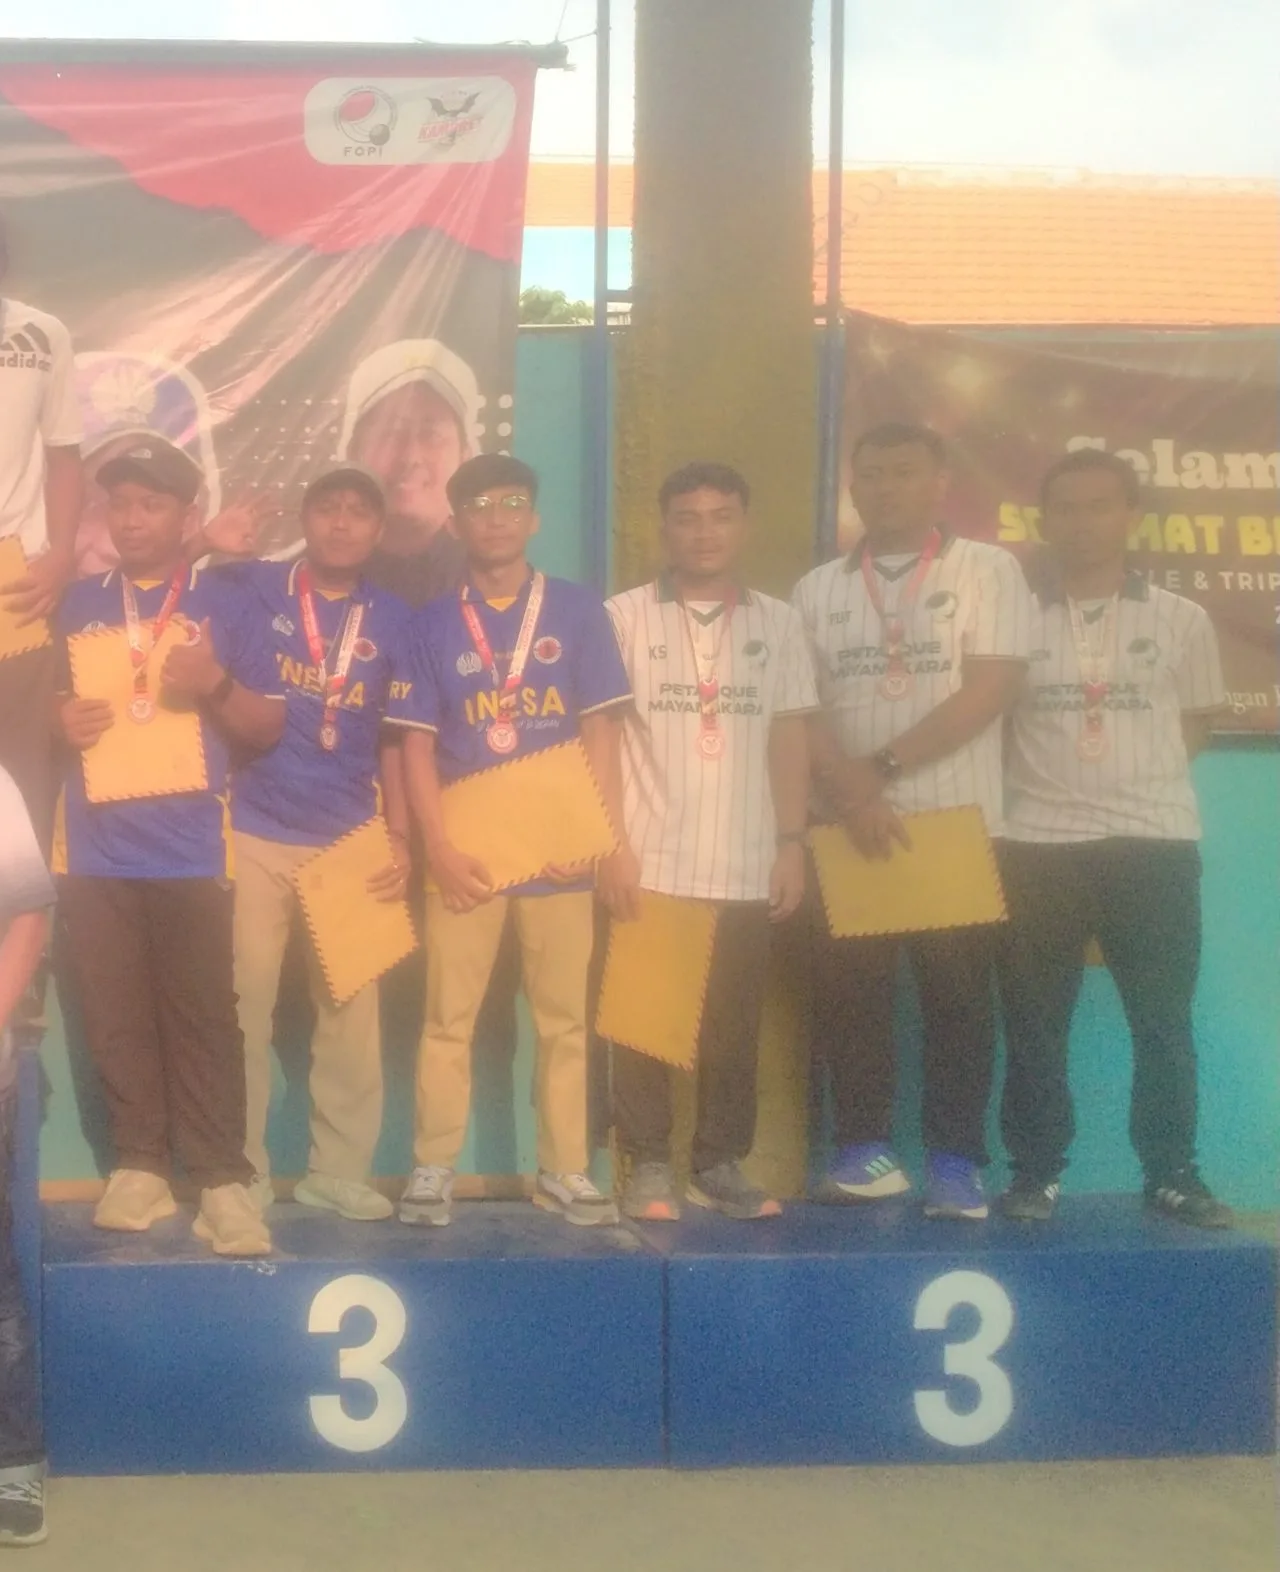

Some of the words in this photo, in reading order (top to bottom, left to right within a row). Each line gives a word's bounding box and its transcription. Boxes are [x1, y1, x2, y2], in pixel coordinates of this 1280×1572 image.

[343, 146, 383, 157] FOPI
[1194, 570, 1209, 590] &
[307, 1273, 408, 1453] 3
[914, 1269, 1014, 1447] 3
